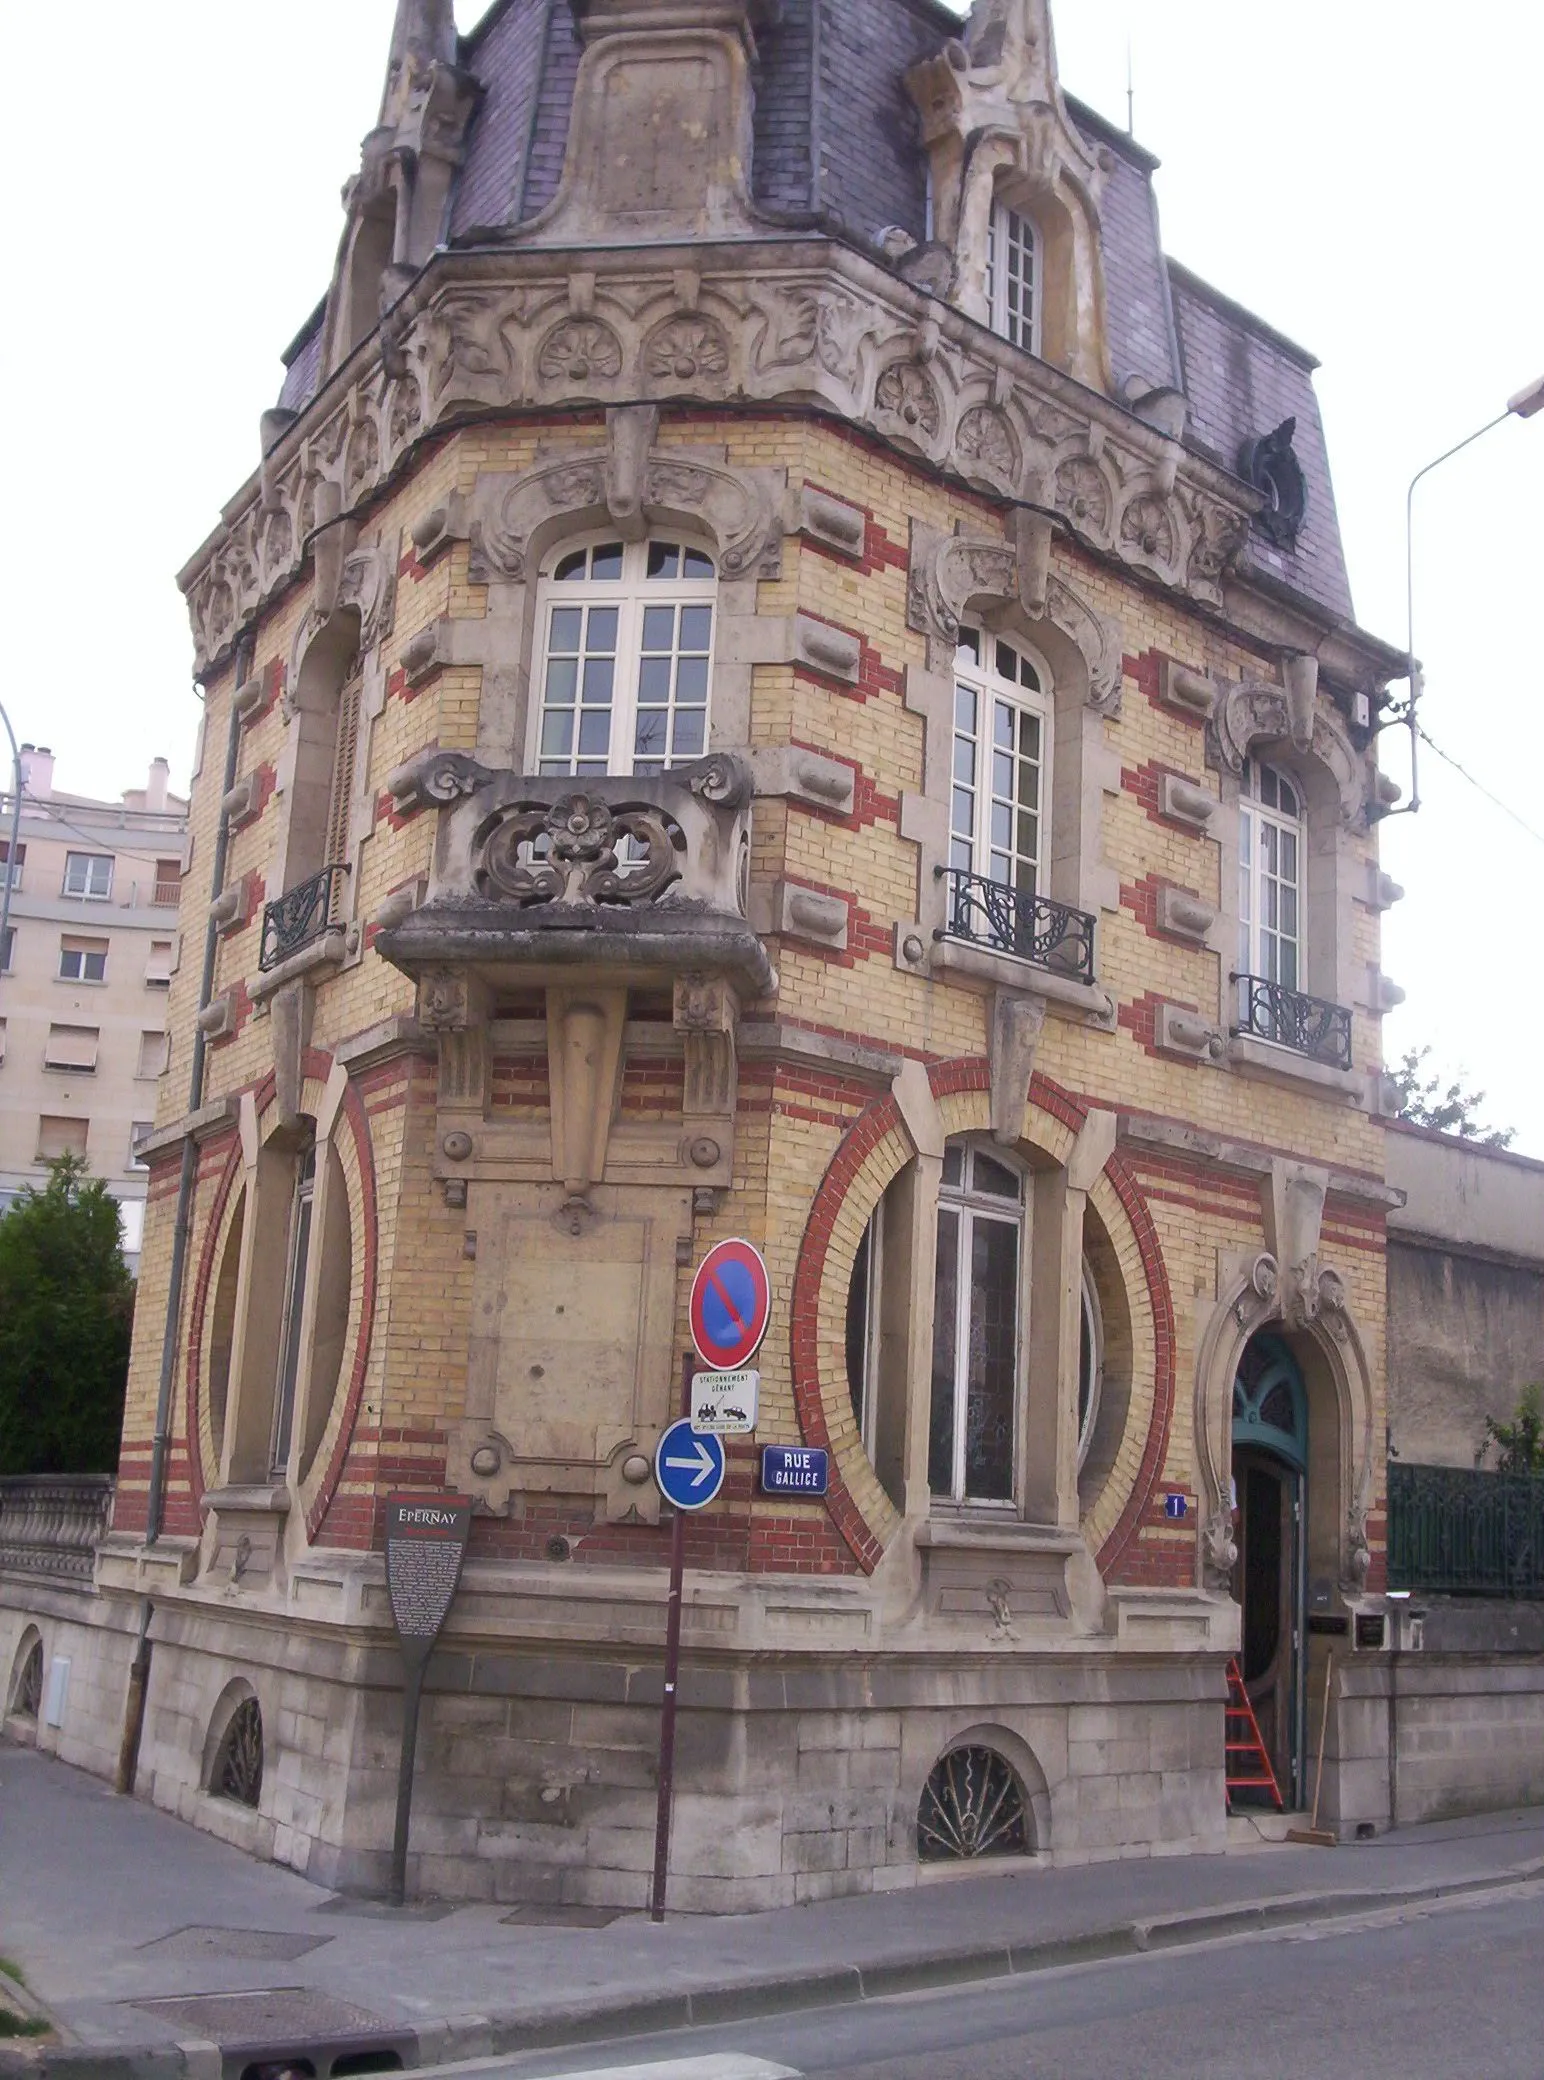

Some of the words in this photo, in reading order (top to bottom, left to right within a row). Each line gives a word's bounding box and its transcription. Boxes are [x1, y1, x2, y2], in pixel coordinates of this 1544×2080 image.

[699, 1374, 748, 1383] STATIONNEMENT
[784, 1453, 811, 1469] RUE
[775, 1471, 818, 1486] GALLICE
[398, 1508, 457, 1525] EPERNAY
